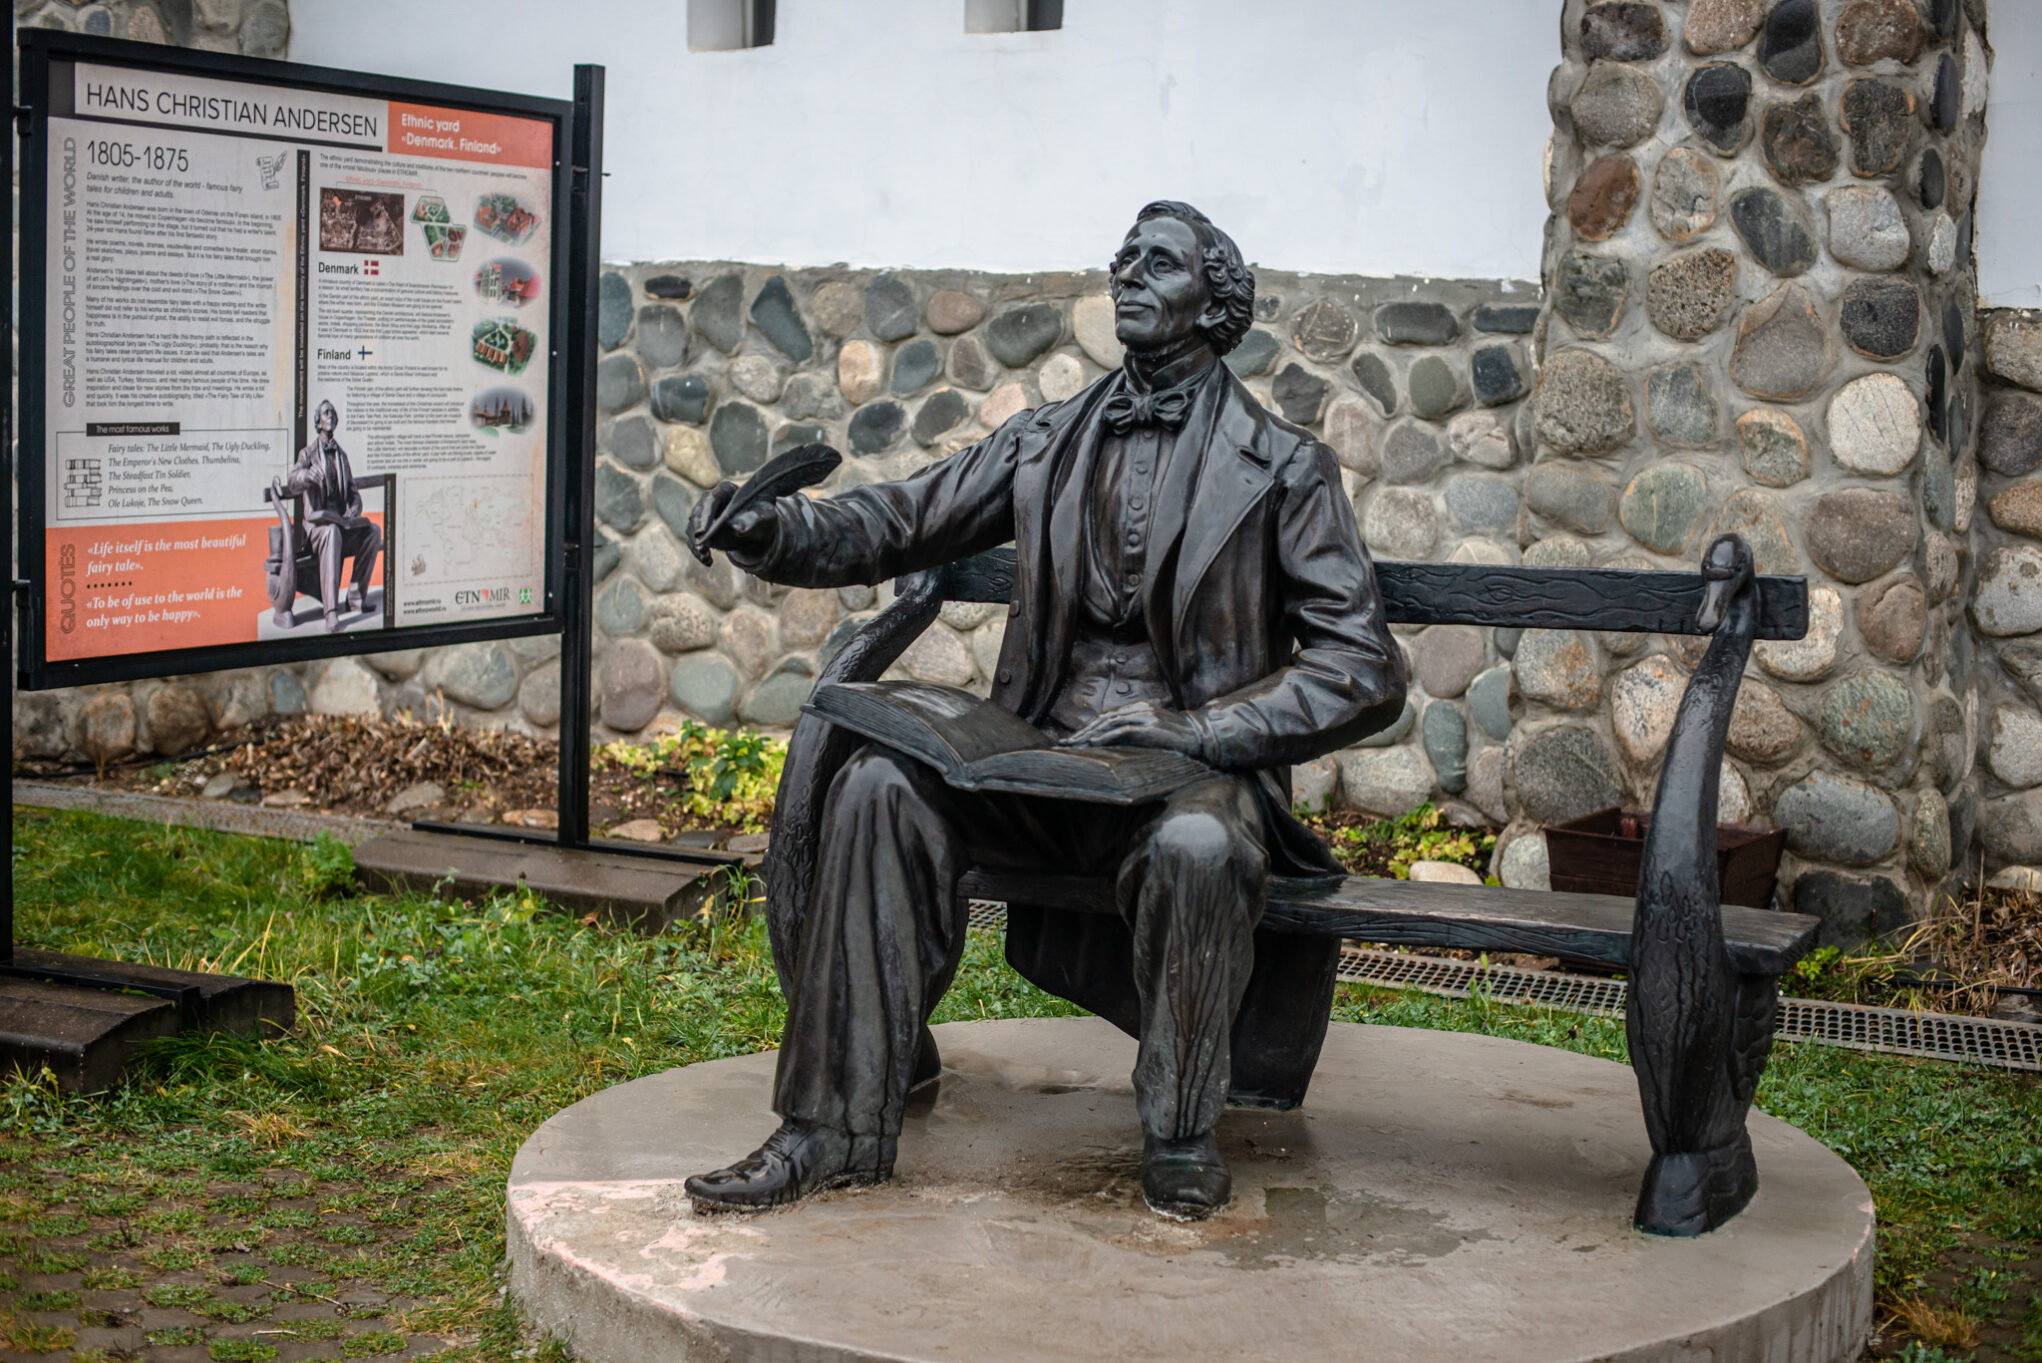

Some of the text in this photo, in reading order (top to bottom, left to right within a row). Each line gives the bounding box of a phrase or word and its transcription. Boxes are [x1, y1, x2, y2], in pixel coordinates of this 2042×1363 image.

[87, 82, 377, 138] HANS CHRISTIAN ANDERSEN
[401, 113, 460, 134] Ethnic yard
[87, 140, 189, 172] 1805-1875
[62, 136, 76, 408] GREAT PEOPLE OF THE WORLD
[318, 261, 359, 275] Denmark
[317, 348, 351, 361] Finland
[96, 424, 169, 433] The most famous works
[108, 443, 126, 455] Fairy
[146, 443, 159, 453] The
[160, 443, 178, 452] Little
[211, 442, 224, 451] The
[225, 442, 240, 453] Ugly
[108, 457, 121, 467] The
[158, 457, 172, 466] New
[108, 471, 121, 481] The
[122, 470, 153, 481] Steadfast
[155, 470, 166, 479] Tin
[108, 485, 137, 494] Princess
[138, 486, 147, 494] on
[148, 484, 159, 493] the
[108, 499, 121, 508] Ole
[148, 497, 161, 507] The
[161, 497, 179, 506] Snow
[88, 534, 247, 558] «Life itself is the most beautiful
[85, 561, 113, 577] fairy
[60, 543, 76, 634] QUOTES
[86, 585, 243, 611] «To be of use to the world is the
[86, 613, 110, 630] only
[112, 615, 133, 628] way
[134, 612, 146, 624] to
[148, 610, 160, 623] be
